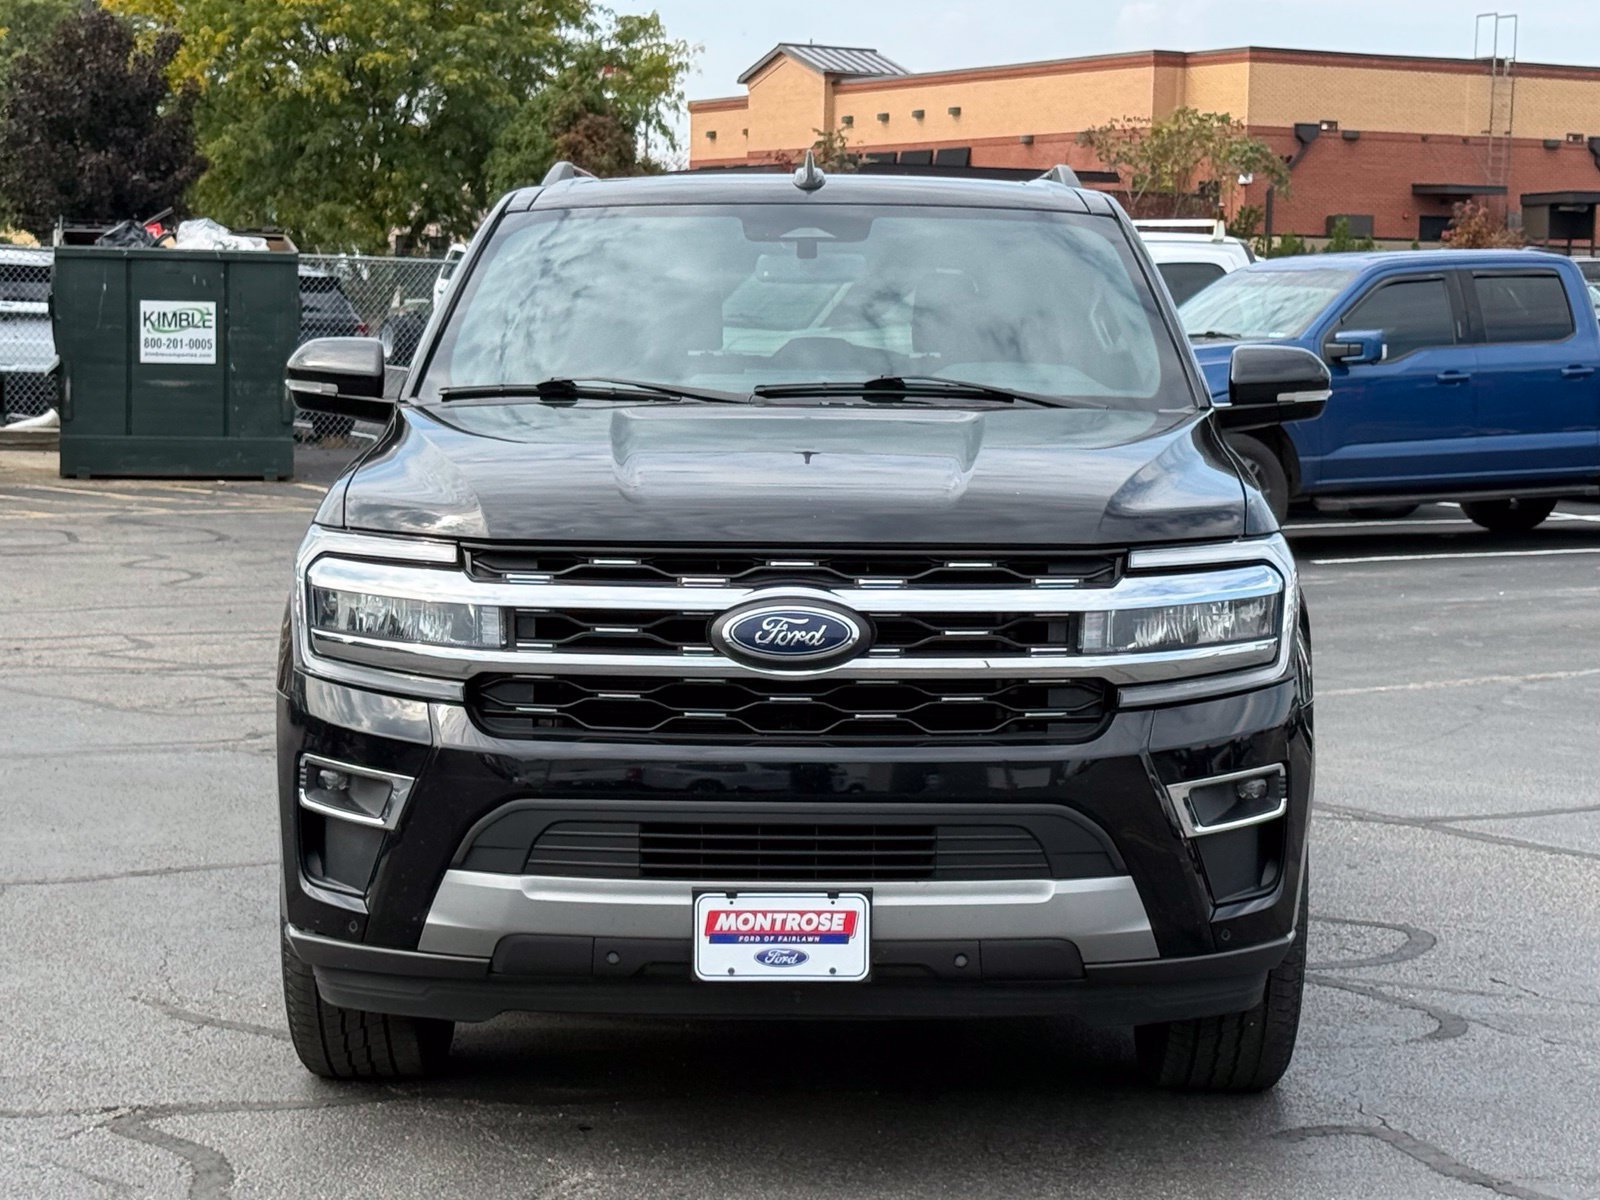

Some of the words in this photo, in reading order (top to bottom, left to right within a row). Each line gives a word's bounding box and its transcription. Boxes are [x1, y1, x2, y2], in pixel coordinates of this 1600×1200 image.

[143, 310, 213, 328] KIMBLE
[144, 337, 213, 350] 800-201-0005
[755, 616, 827, 646] Ford
[714, 912, 847, 932] MONTROSE
[764, 949, 798, 965] Ford
